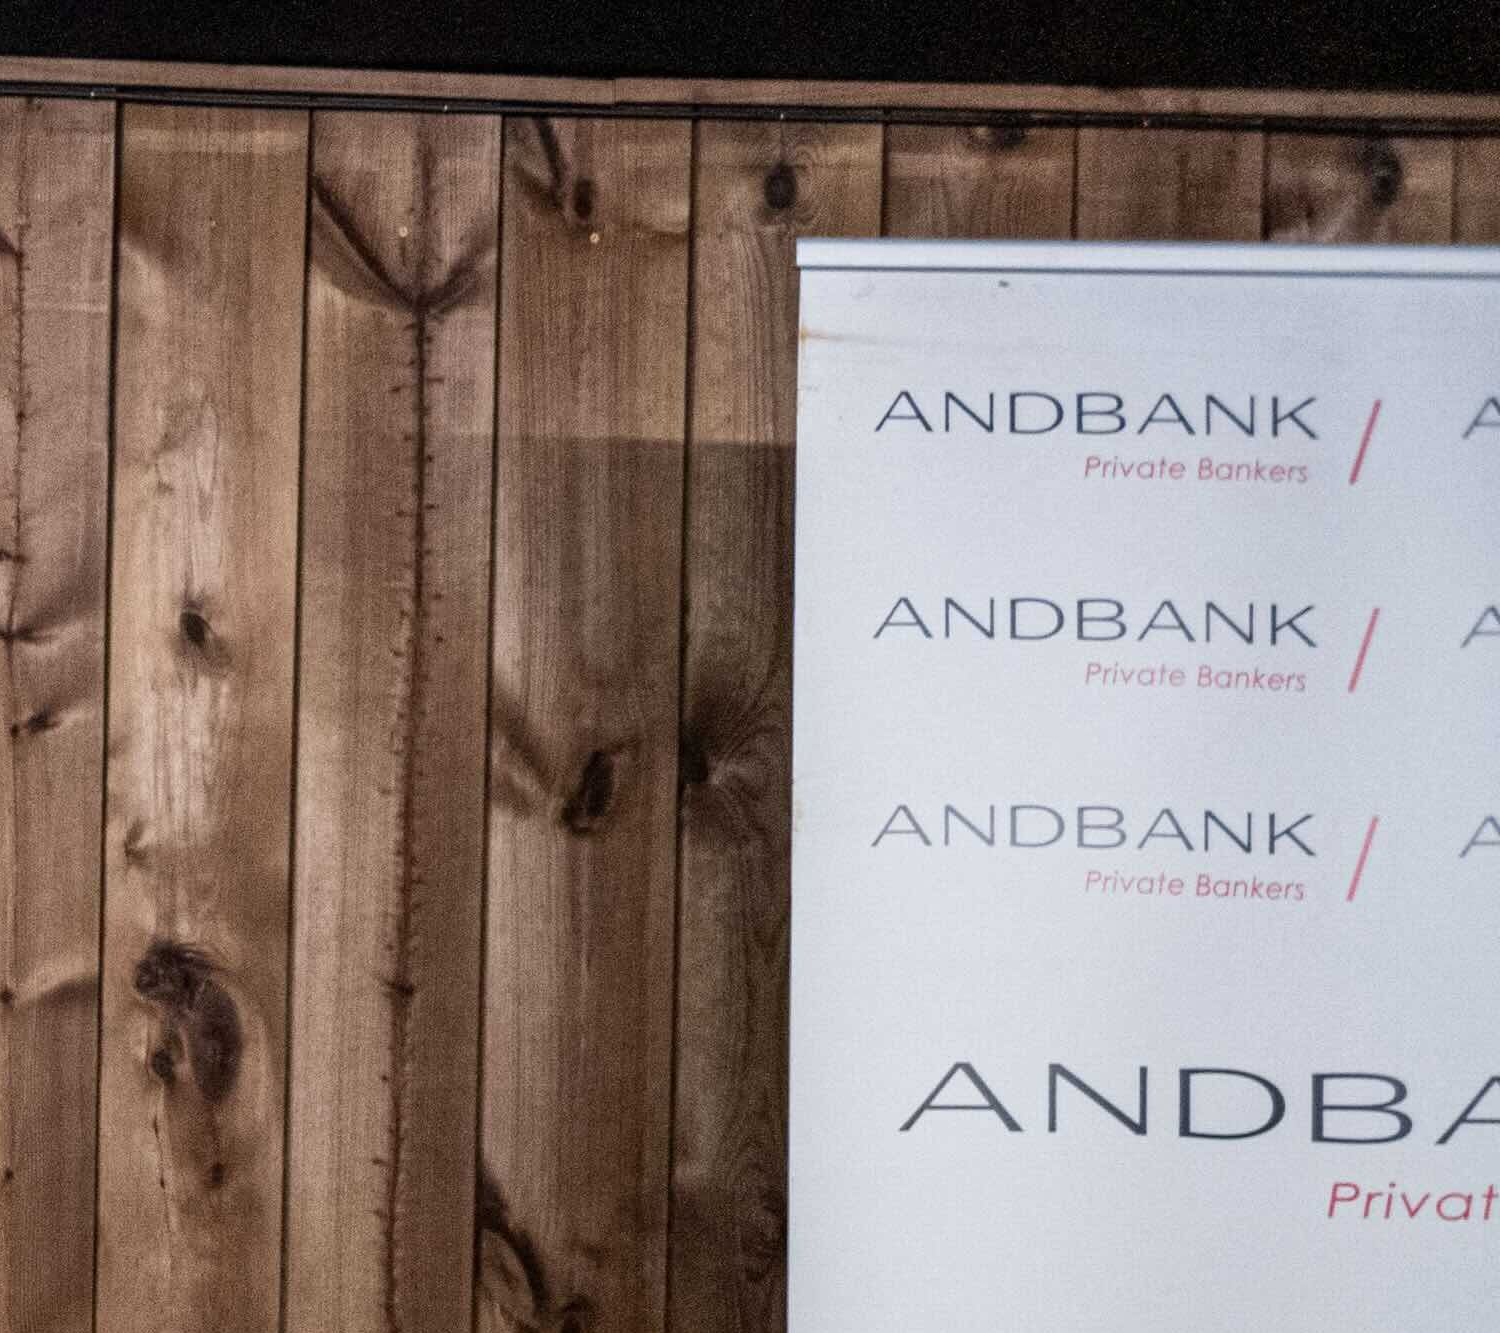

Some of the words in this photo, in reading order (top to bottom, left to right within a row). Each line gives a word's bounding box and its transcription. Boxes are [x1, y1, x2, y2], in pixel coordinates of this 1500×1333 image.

[874, 390, 1320, 440] ANDBANK
[1084, 456, 1186, 481] Private
[1197, 457, 1308, 484] Bankers
[873, 596, 1318, 648] ANDBANK
[1085, 663, 1186, 688] Private
[1196, 665, 1307, 692] Bankers
[870, 804, 1317, 857] ANDBANK
[1085, 870, 1185, 896] Private
[1195, 872, 1305, 901] Bankers
[899, 1061, 1500, 1146] ANDBA
